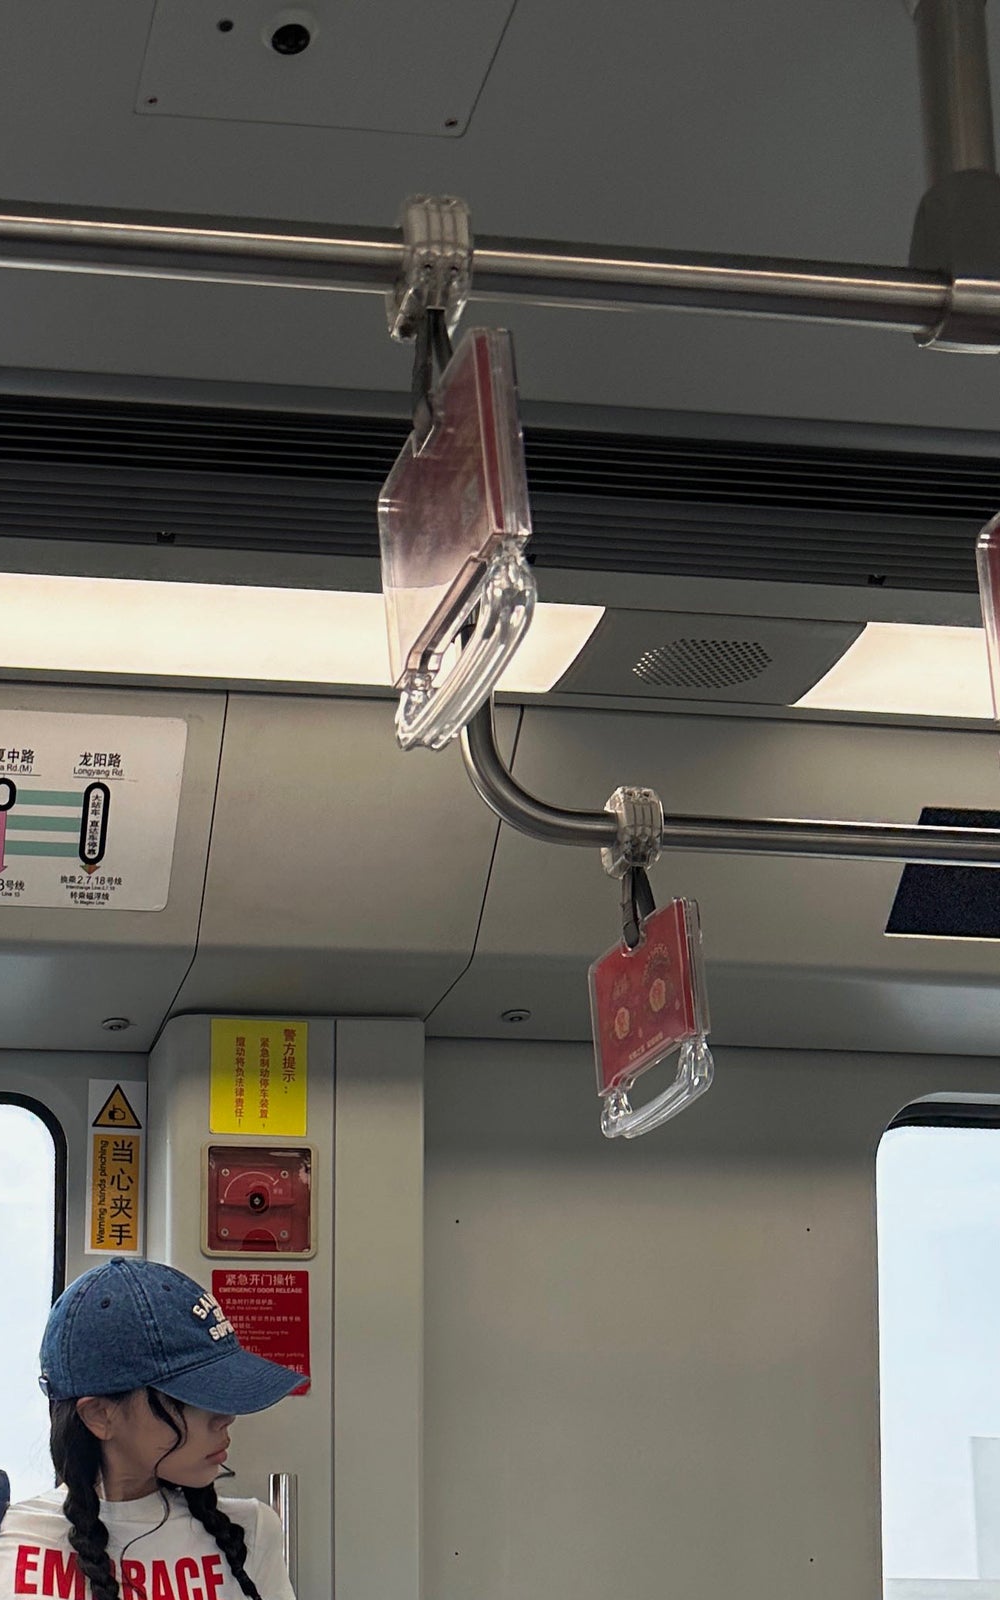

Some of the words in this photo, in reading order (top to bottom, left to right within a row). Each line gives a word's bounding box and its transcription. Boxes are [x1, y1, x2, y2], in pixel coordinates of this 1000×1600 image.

[6, 764, 33, 774] Rd.(M)
[78, 752, 122, 768] 龙阳路
[73, 767, 110, 778] Longyang
[111, 768, 125, 777] Rd.
[98, 1140, 110, 1177] pinching
[97, 1179, 107, 1205] hands
[109, 1139, 134, 1246] 当心夹手
[96, 1208, 107, 1244] Warning
[225, 1273, 296, 1286] 紧急开门操作
